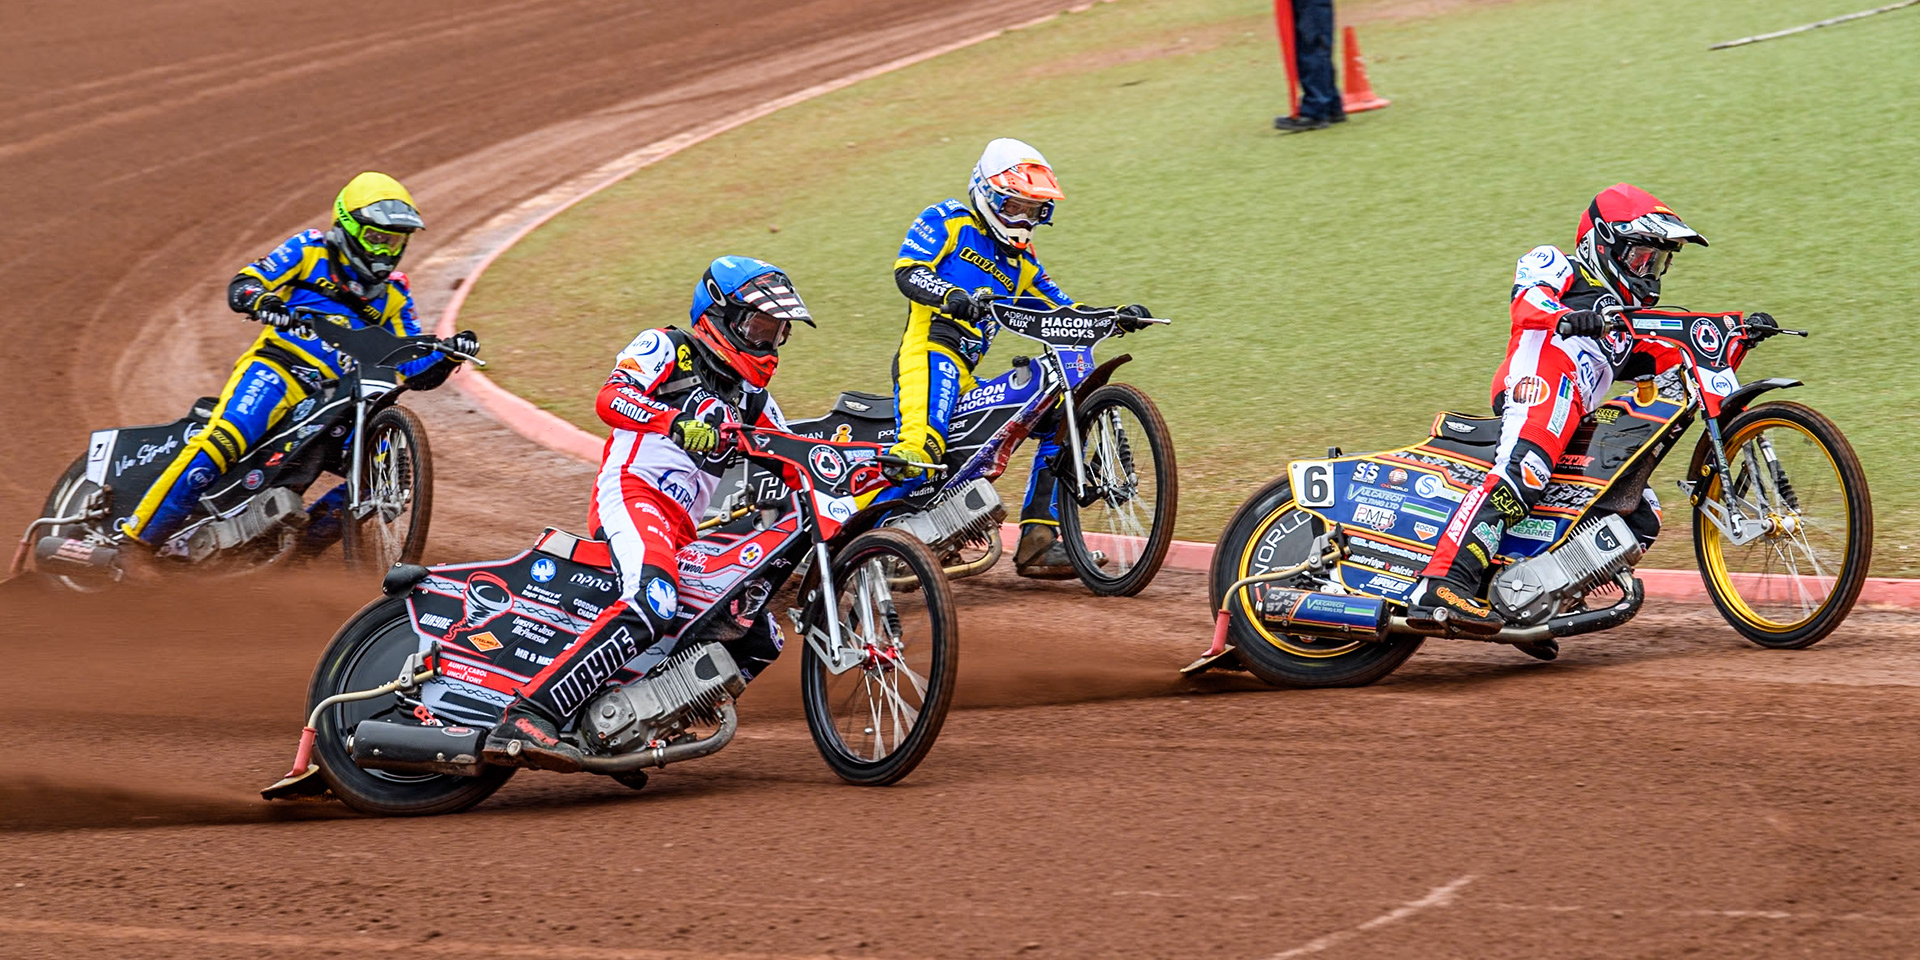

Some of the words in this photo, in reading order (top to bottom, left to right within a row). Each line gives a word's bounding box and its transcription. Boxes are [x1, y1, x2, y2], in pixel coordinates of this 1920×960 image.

[909, 274, 948, 297] SHOCKS
[1003, 311, 1035, 323] ADRIAN
[1009, 319, 1028, 328] FLUX
[1041, 317, 1092, 328] HAGON
[1041, 328, 1095, 338] SHOCKS
[948, 419, 968, 432] ger
[1304, 465, 1328, 503] 6
[909, 486, 935, 497] Judith
[1347, 484, 1405, 503] VULCATECH
[1416, 523, 1437, 534] ROCOL
[532, 585, 554, 599] Memory
[573, 599, 598, 612] GORDON
[1436, 586, 1491, 618] daytona
[419, 613, 453, 630] WAYNE
[577, 608, 599, 621] CHAPM
[514, 647, 527, 660] MR
[528, 653, 536, 662] &
[447, 661, 469, 673] AUNTY
[468, 666, 487, 678] CAROL
[549, 625, 638, 718] WAYNE
[446, 670, 466, 680] UNCLE
[465, 675, 483, 685] TONY
